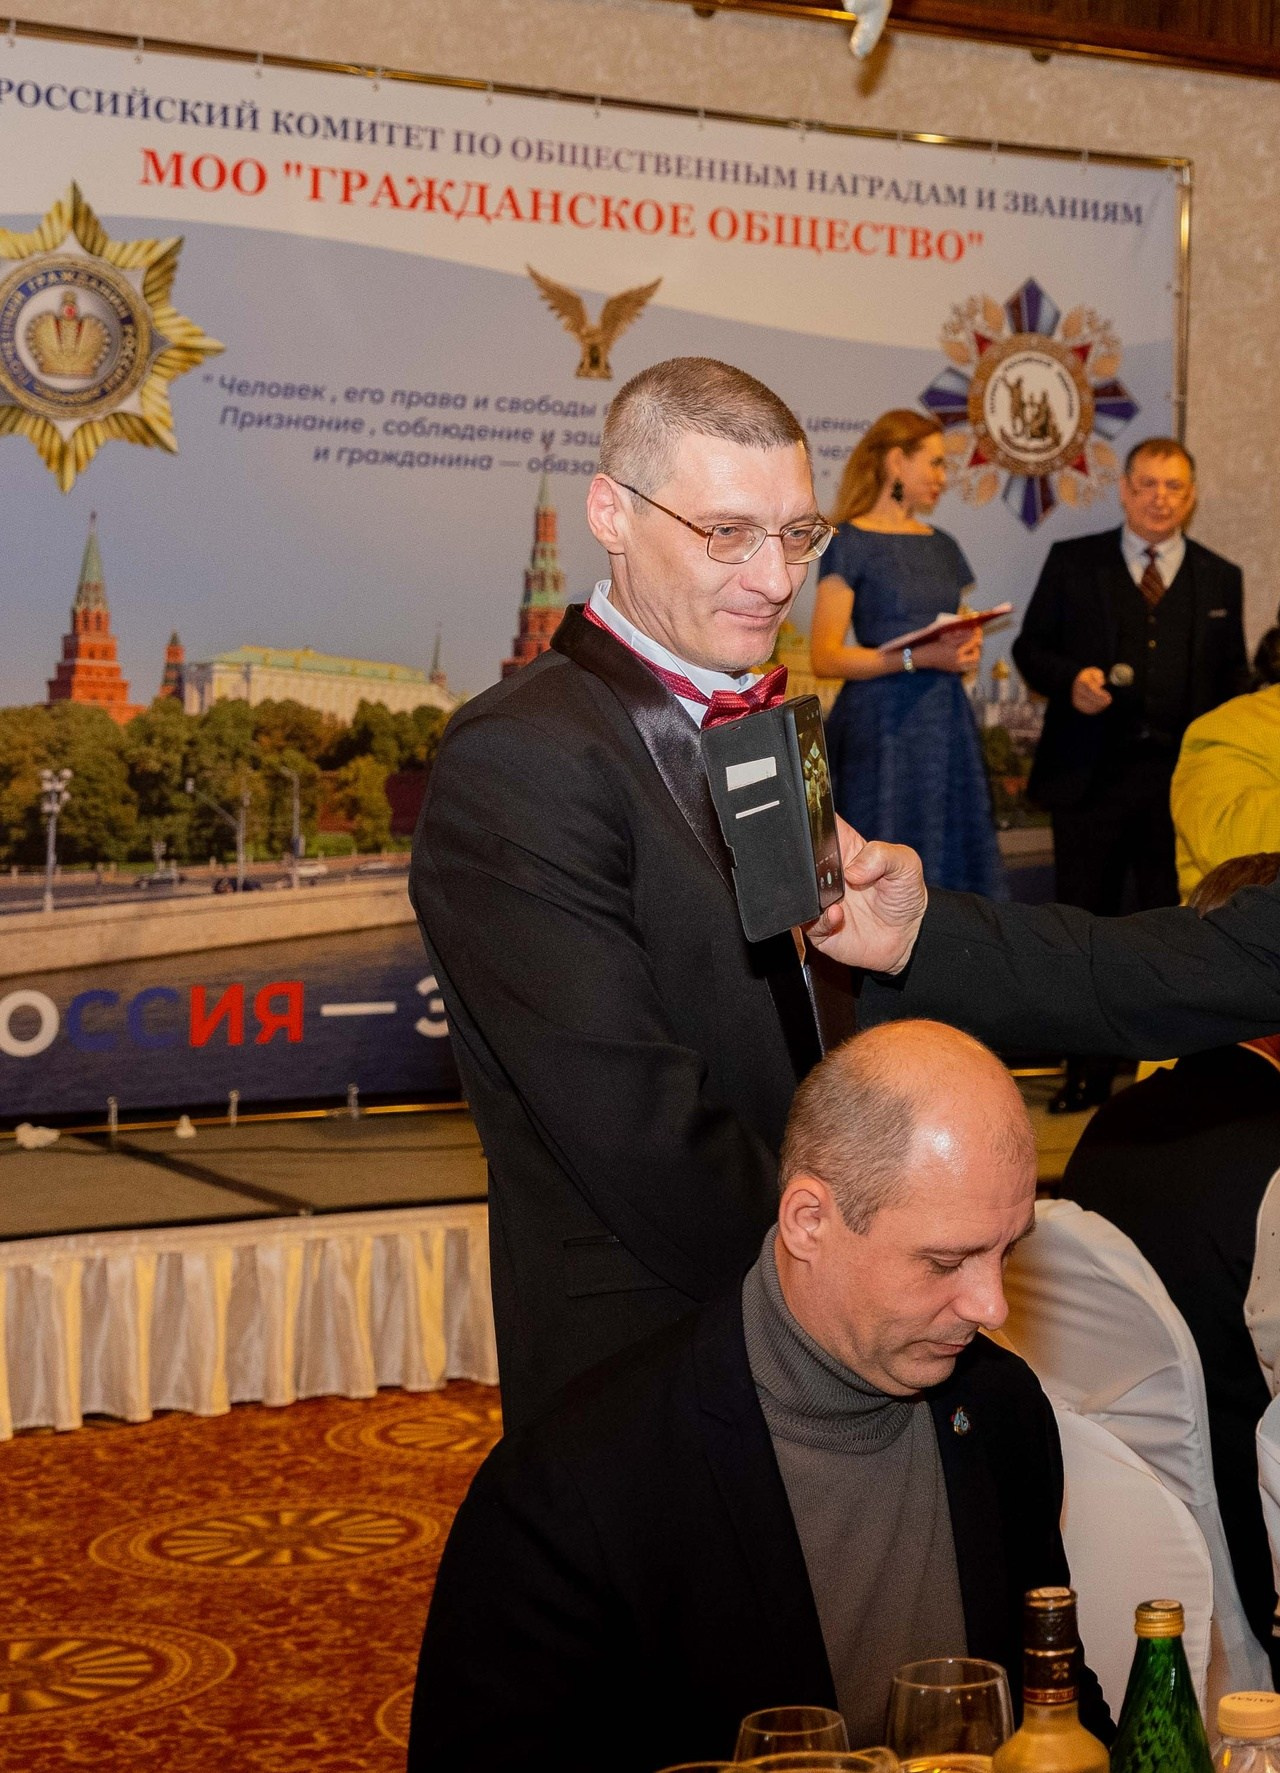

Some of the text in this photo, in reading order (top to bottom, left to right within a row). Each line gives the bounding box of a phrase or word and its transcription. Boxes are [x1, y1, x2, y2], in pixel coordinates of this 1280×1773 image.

[0, 77, 1144, 227] РОССИЙСКИЙ КОМИТЕТ ПО ОБЩЕСТВЕННЫМ НАГРАДАМ И ЗВАНИЯМ
[140, 147, 985, 264] МОО "ГРАЖДАНСКОЕ ОБЩЕСТВО"
[344, 385, 386, 406] его
[390, 388, 468, 411] права
[472, 393, 490, 412] и
[494, 394, 598, 418] свободы
[381, 416, 535, 444] соблюдение
[312, 445, 332, 463] и
[335, 447, 494, 472] гражданина
[526, 453, 600, 476] обяза
